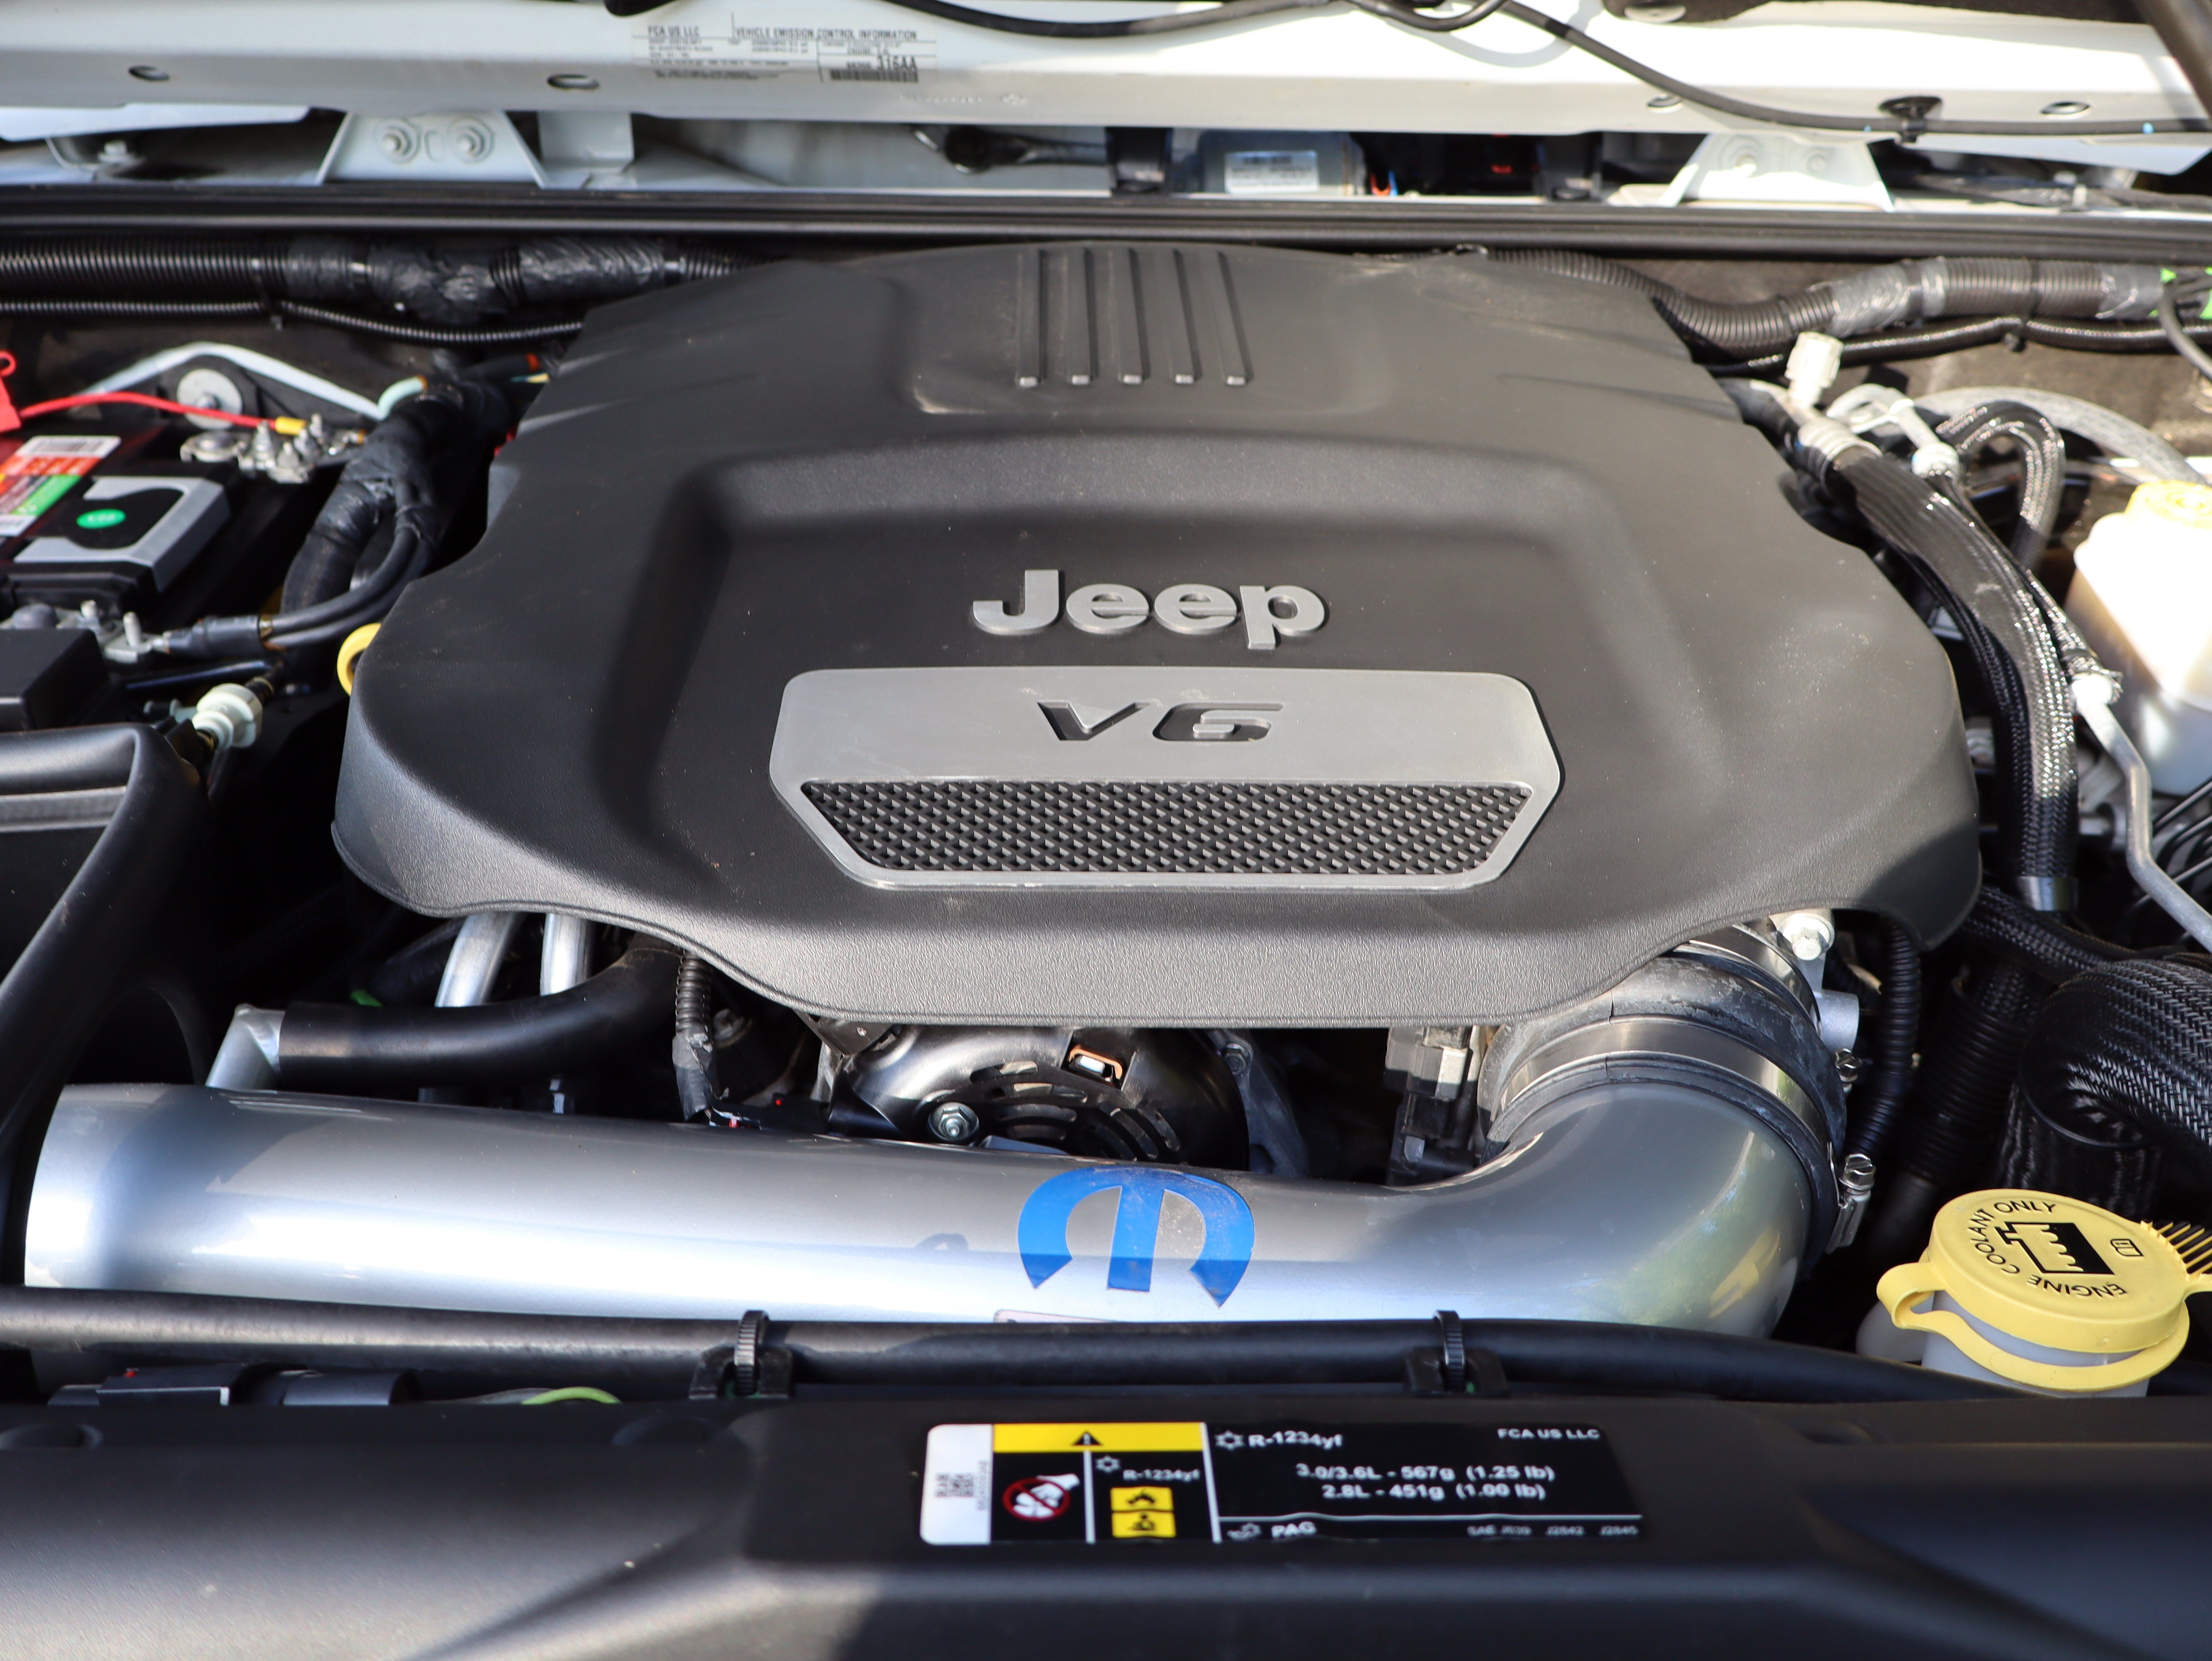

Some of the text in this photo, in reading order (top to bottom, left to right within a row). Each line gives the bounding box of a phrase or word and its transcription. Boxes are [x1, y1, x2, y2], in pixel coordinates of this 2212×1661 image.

[648, 25, 700, 37] FCA US LLC
[736, 27, 917, 40] VEHICLE EMISSION CONTROL INFORMATION
[972, 569, 1327, 649] Jeep
[1037, 701, 1284, 741] V6
[1968, 1200, 2127, 1297] ENGINE COOLANT ONLY
[1248, 1430, 1343, 1450] R-1234yf
[1498, 1428, 1600, 1439] FCA US LLC
[1123, 1469, 1200, 1482] R-1234yf
[1296, 1463, 1382, 1480] 3.0/3.6L
[1401, 1465, 1455, 1482] 567g
[1466, 1465, 1520, 1482] (1.25
[1524, 1465, 1555, 1482] lb)
[1321, 1484, 1371, 1499] 2.8L
[1389, 1484, 1445, 1501] 451g
[1456, 1483, 1510, 1500] (1.00
[1514, 1483, 1546, 1500] lb)
[1271, 1521, 1317, 1538] PAG
